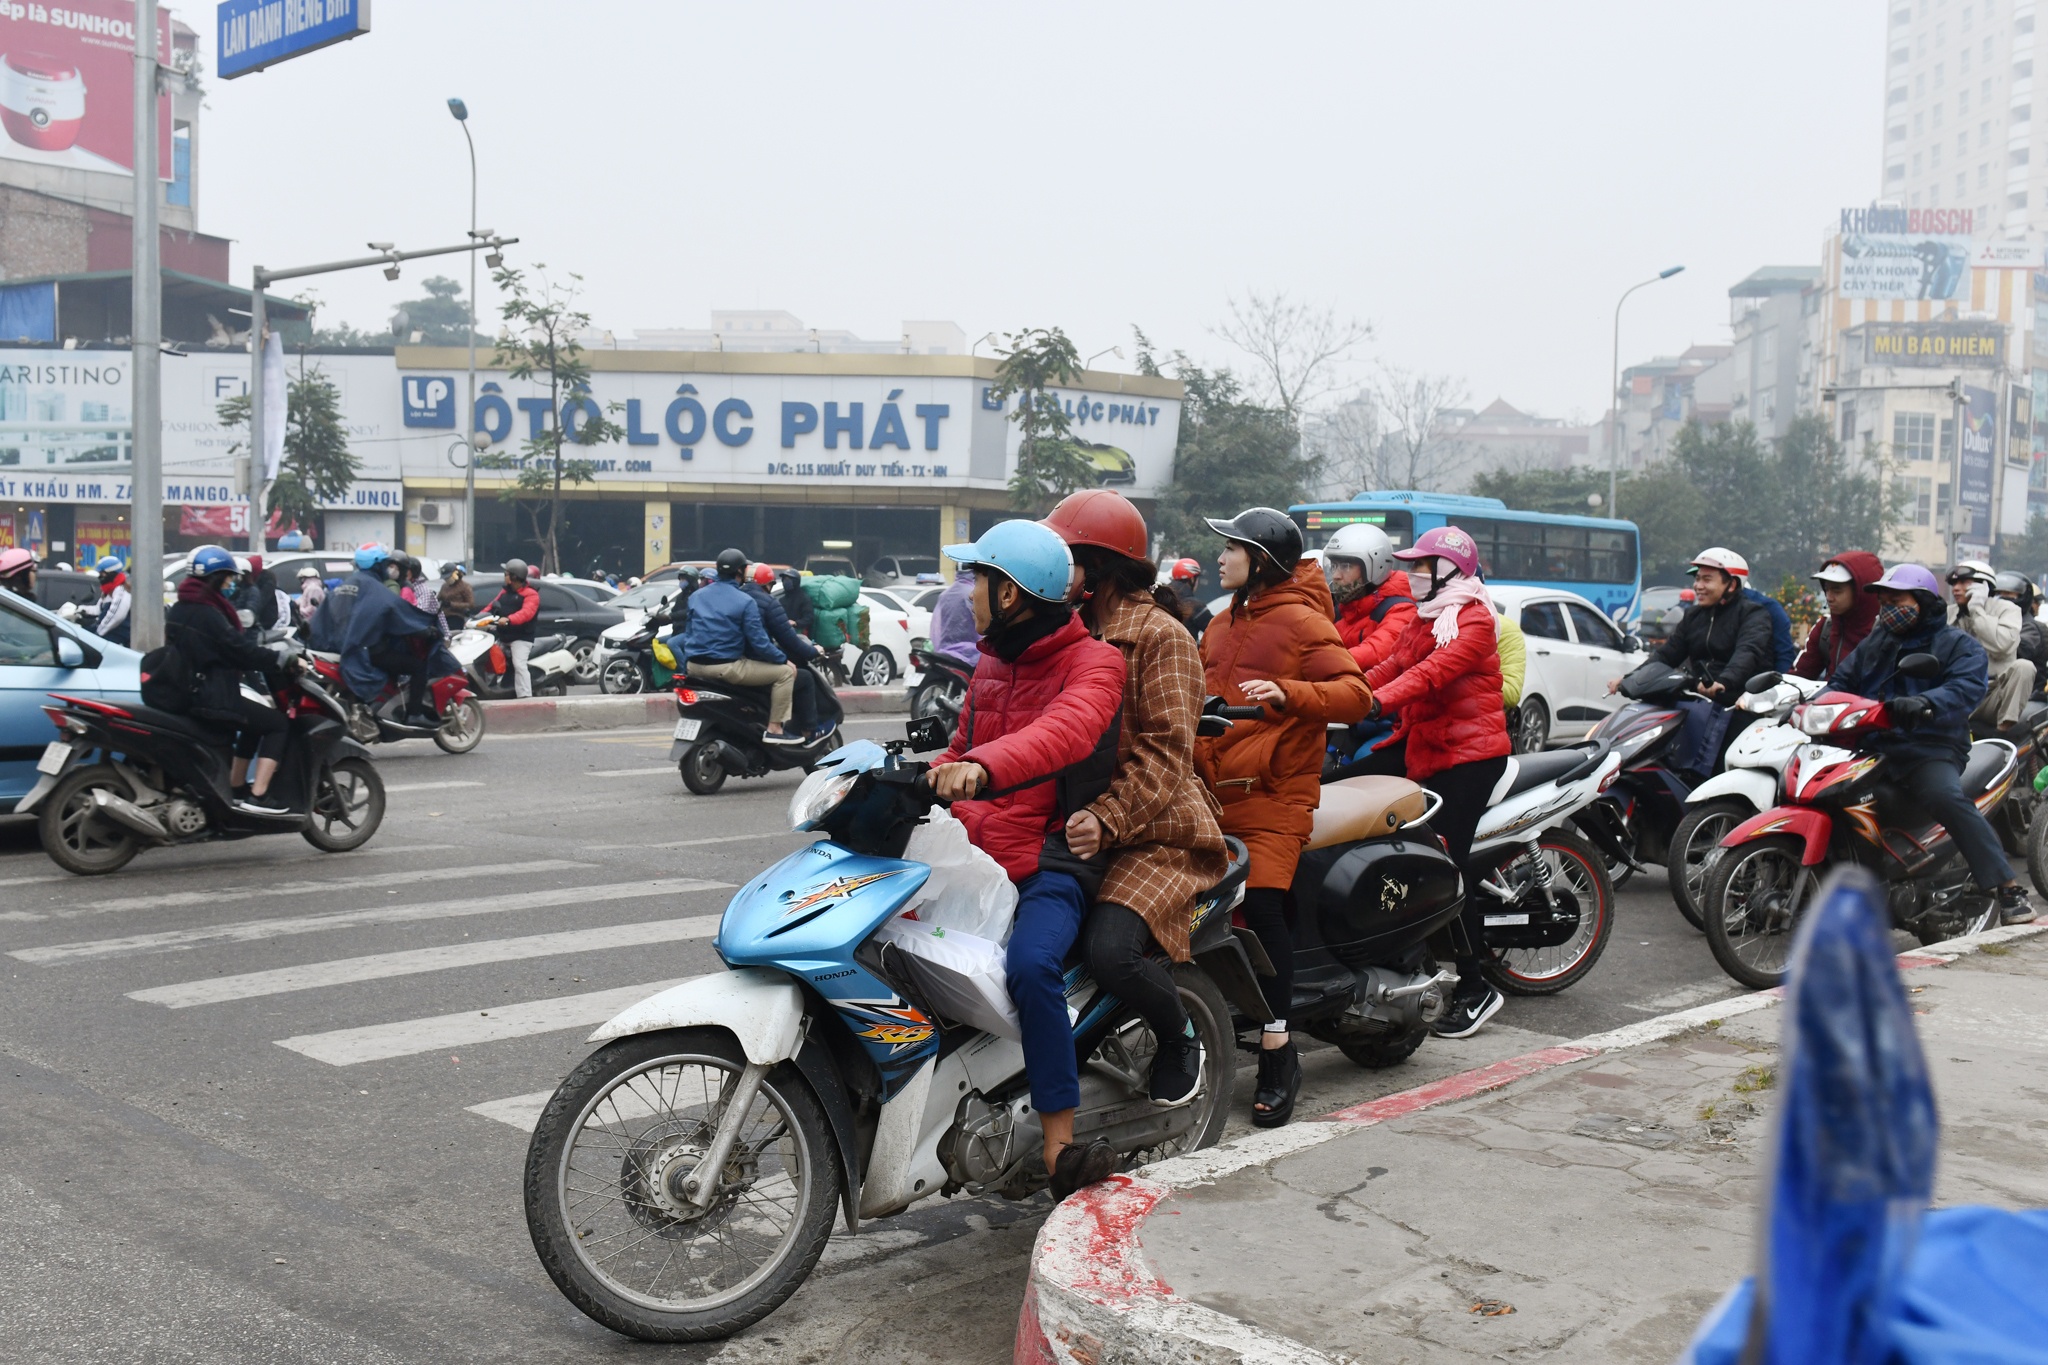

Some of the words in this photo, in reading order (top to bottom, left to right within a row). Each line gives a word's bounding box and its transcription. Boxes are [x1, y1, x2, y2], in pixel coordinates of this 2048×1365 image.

[28, 2, 48, 24] là
[223, 9, 247, 58] LÀN
[249, 0, 282, 49] DÀNH
[1908, 208, 1973, 235] BOSCH
[1876, 265, 1920, 276] KHOAN
[0, 366, 121, 385] ARISTINO
[407, 380, 448, 409] LP
[627, 383, 754, 460] LỘC
[781, 389, 950, 450] PHÁT
[1065, 395, 1104, 425] LỘC
[1108, 401, 1160, 426] PHÁT
[1964, 428, 1990, 453] Dulux
[796, 463, 814, 476] 115
[816, 460, 851, 476] KHUẤT
[856, 464, 876, 477] DUY
[1860, 793, 1874, 804] SYM
[814, 968, 858, 982] HONDA
